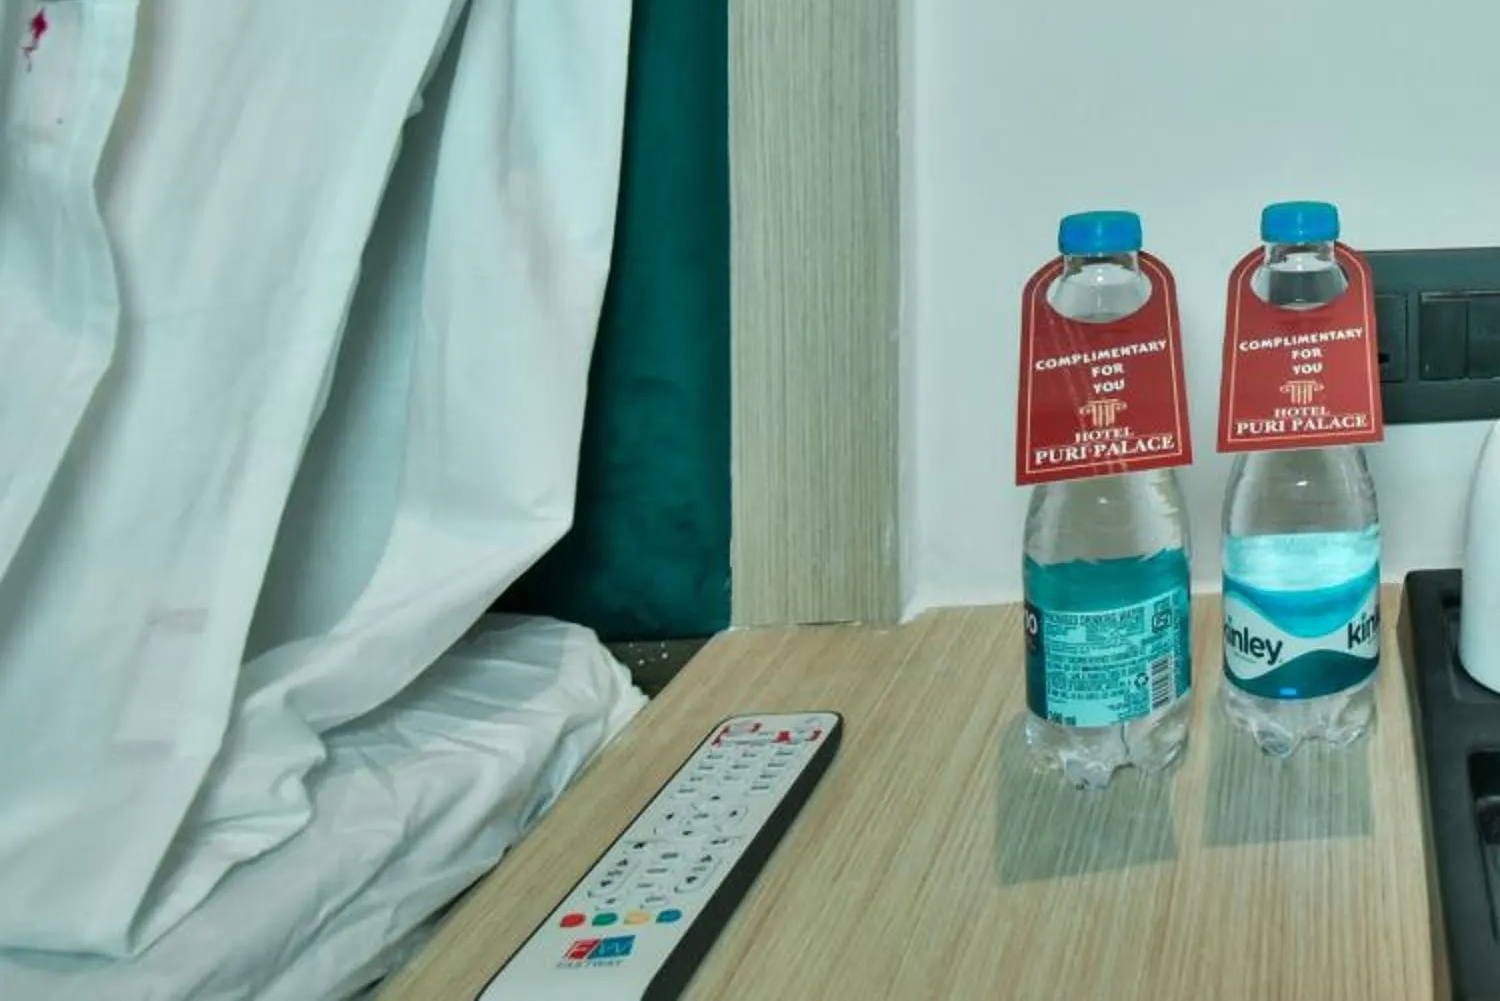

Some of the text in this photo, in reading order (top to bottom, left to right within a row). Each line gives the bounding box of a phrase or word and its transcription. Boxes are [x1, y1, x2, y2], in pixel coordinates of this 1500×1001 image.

[1239, 327, 1363, 351] COMPLIMENTARY
[1035, 339, 1167, 370] COMPLIMENTARY
[1291, 348, 1323, 360] FOR
[1091, 363, 1124, 378] FOR
[1292, 363, 1323, 375] YOU
[1093, 379, 1125, 394] YOU
[1274, 406, 1330, 419] HOTEL
[1236, 414, 1367, 435] PURI PALACE
[1075, 426, 1134, 443] HOTEL
[1035, 434, 1175, 465] PURI PALACE
